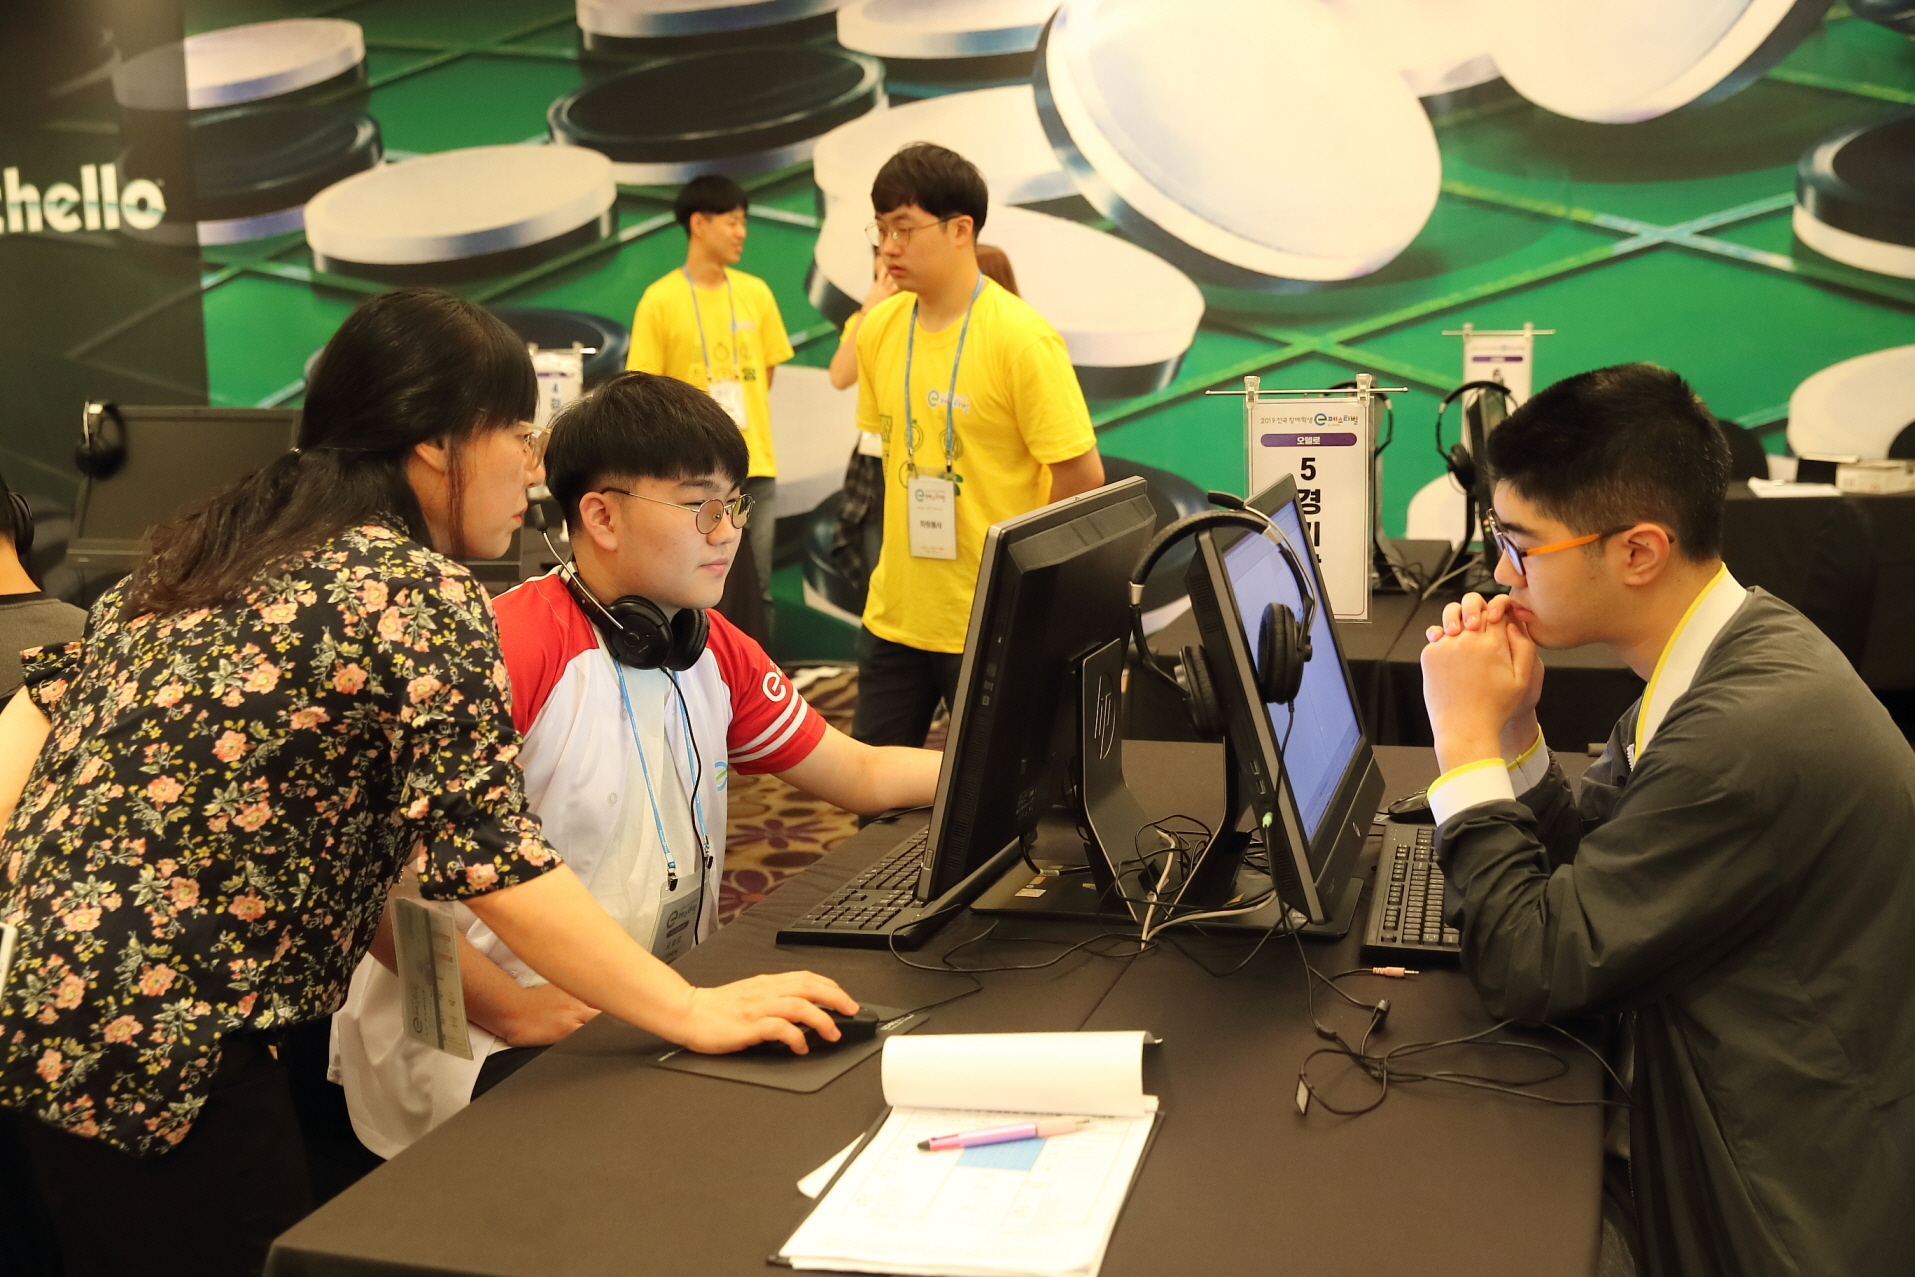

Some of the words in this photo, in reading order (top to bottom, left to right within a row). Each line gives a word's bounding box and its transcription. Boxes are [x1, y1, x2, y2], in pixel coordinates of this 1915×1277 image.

[0, 163, 166, 234] hello
[1260, 417, 1276, 425] 2019
[1296, 436, 1321, 445] 오델로
[1300, 457, 1317, 481] 5
